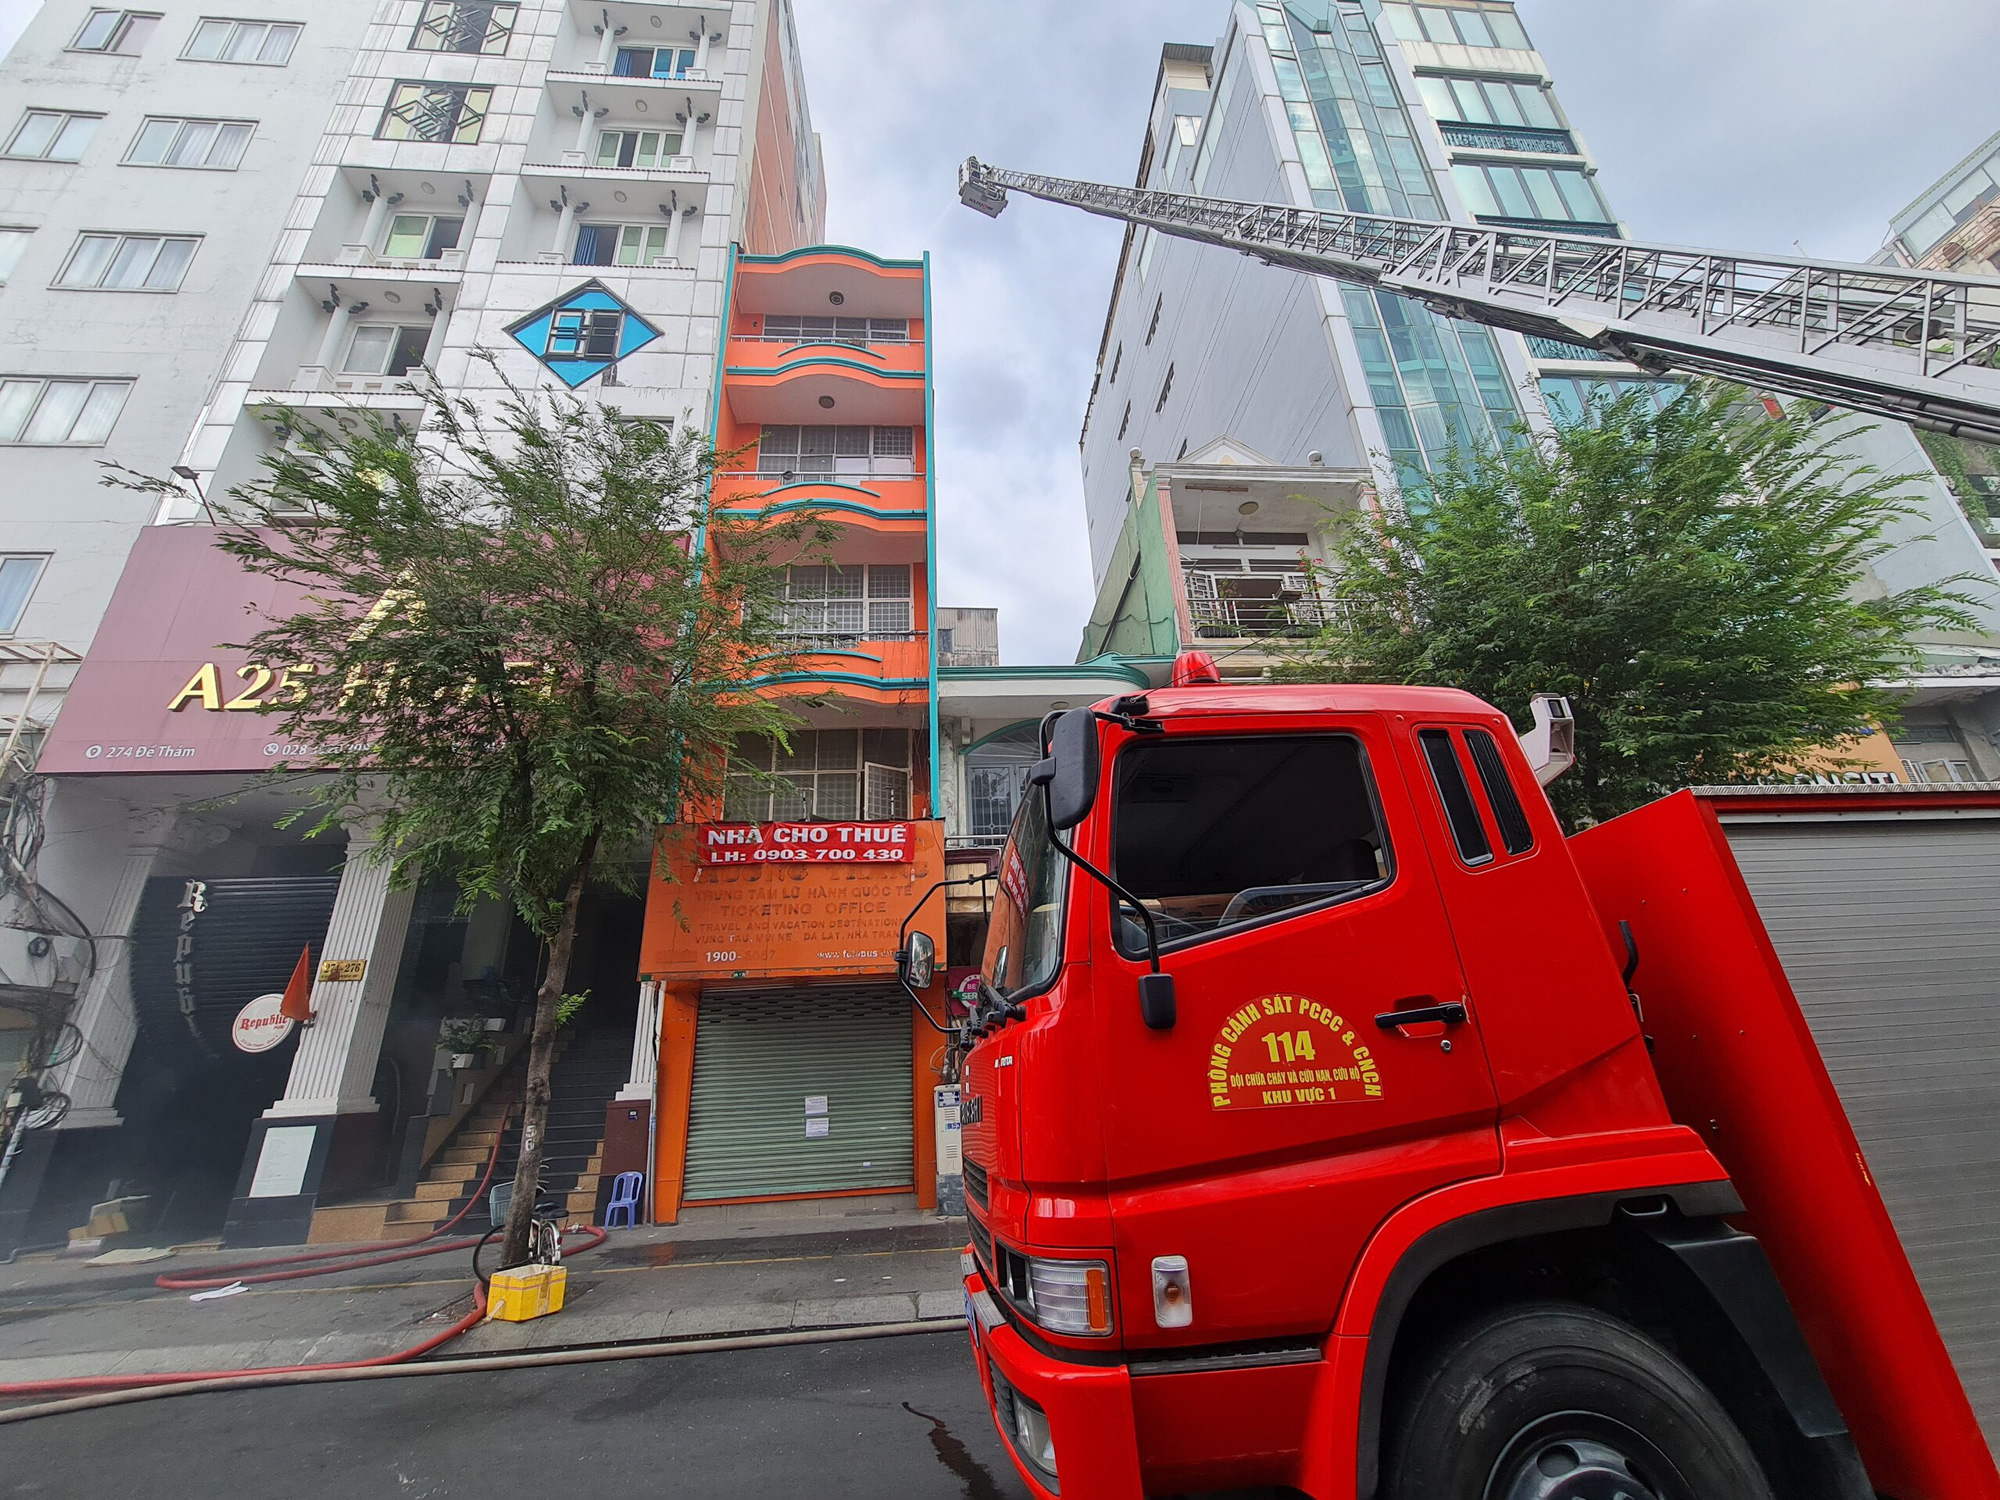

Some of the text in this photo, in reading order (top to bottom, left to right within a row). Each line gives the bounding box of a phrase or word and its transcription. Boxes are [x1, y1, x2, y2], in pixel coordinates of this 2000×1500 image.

[166, 662, 318, 713] A25
[106, 747, 133, 758] 274
[158, 745, 195, 758] Thám
[282, 744, 307, 756] 028
[773, 827, 828, 843] CHO
[837, 824, 907, 843] THUÊ
[711, 848, 904, 863] LH: 0903 700 430
[720, 901, 887, 917] TICKETING OFFICE
[700, 922, 742, 932] TRAVEL
[746, 921, 769, 930] AND
[772, 919, 825, 929] VACATION
[323, 963, 361, 973] 274-276
[240, 1014, 288, 1031] Republic
[1207, 993, 1382, 1107] PHÒNG CẢNH SÁT PCCC & CNCH
[1261, 1030, 1316, 1063] 114
[1286, 1068, 1299, 1083] VÀ
[1262, 1086, 1337, 1105] KHU VỰC 1
